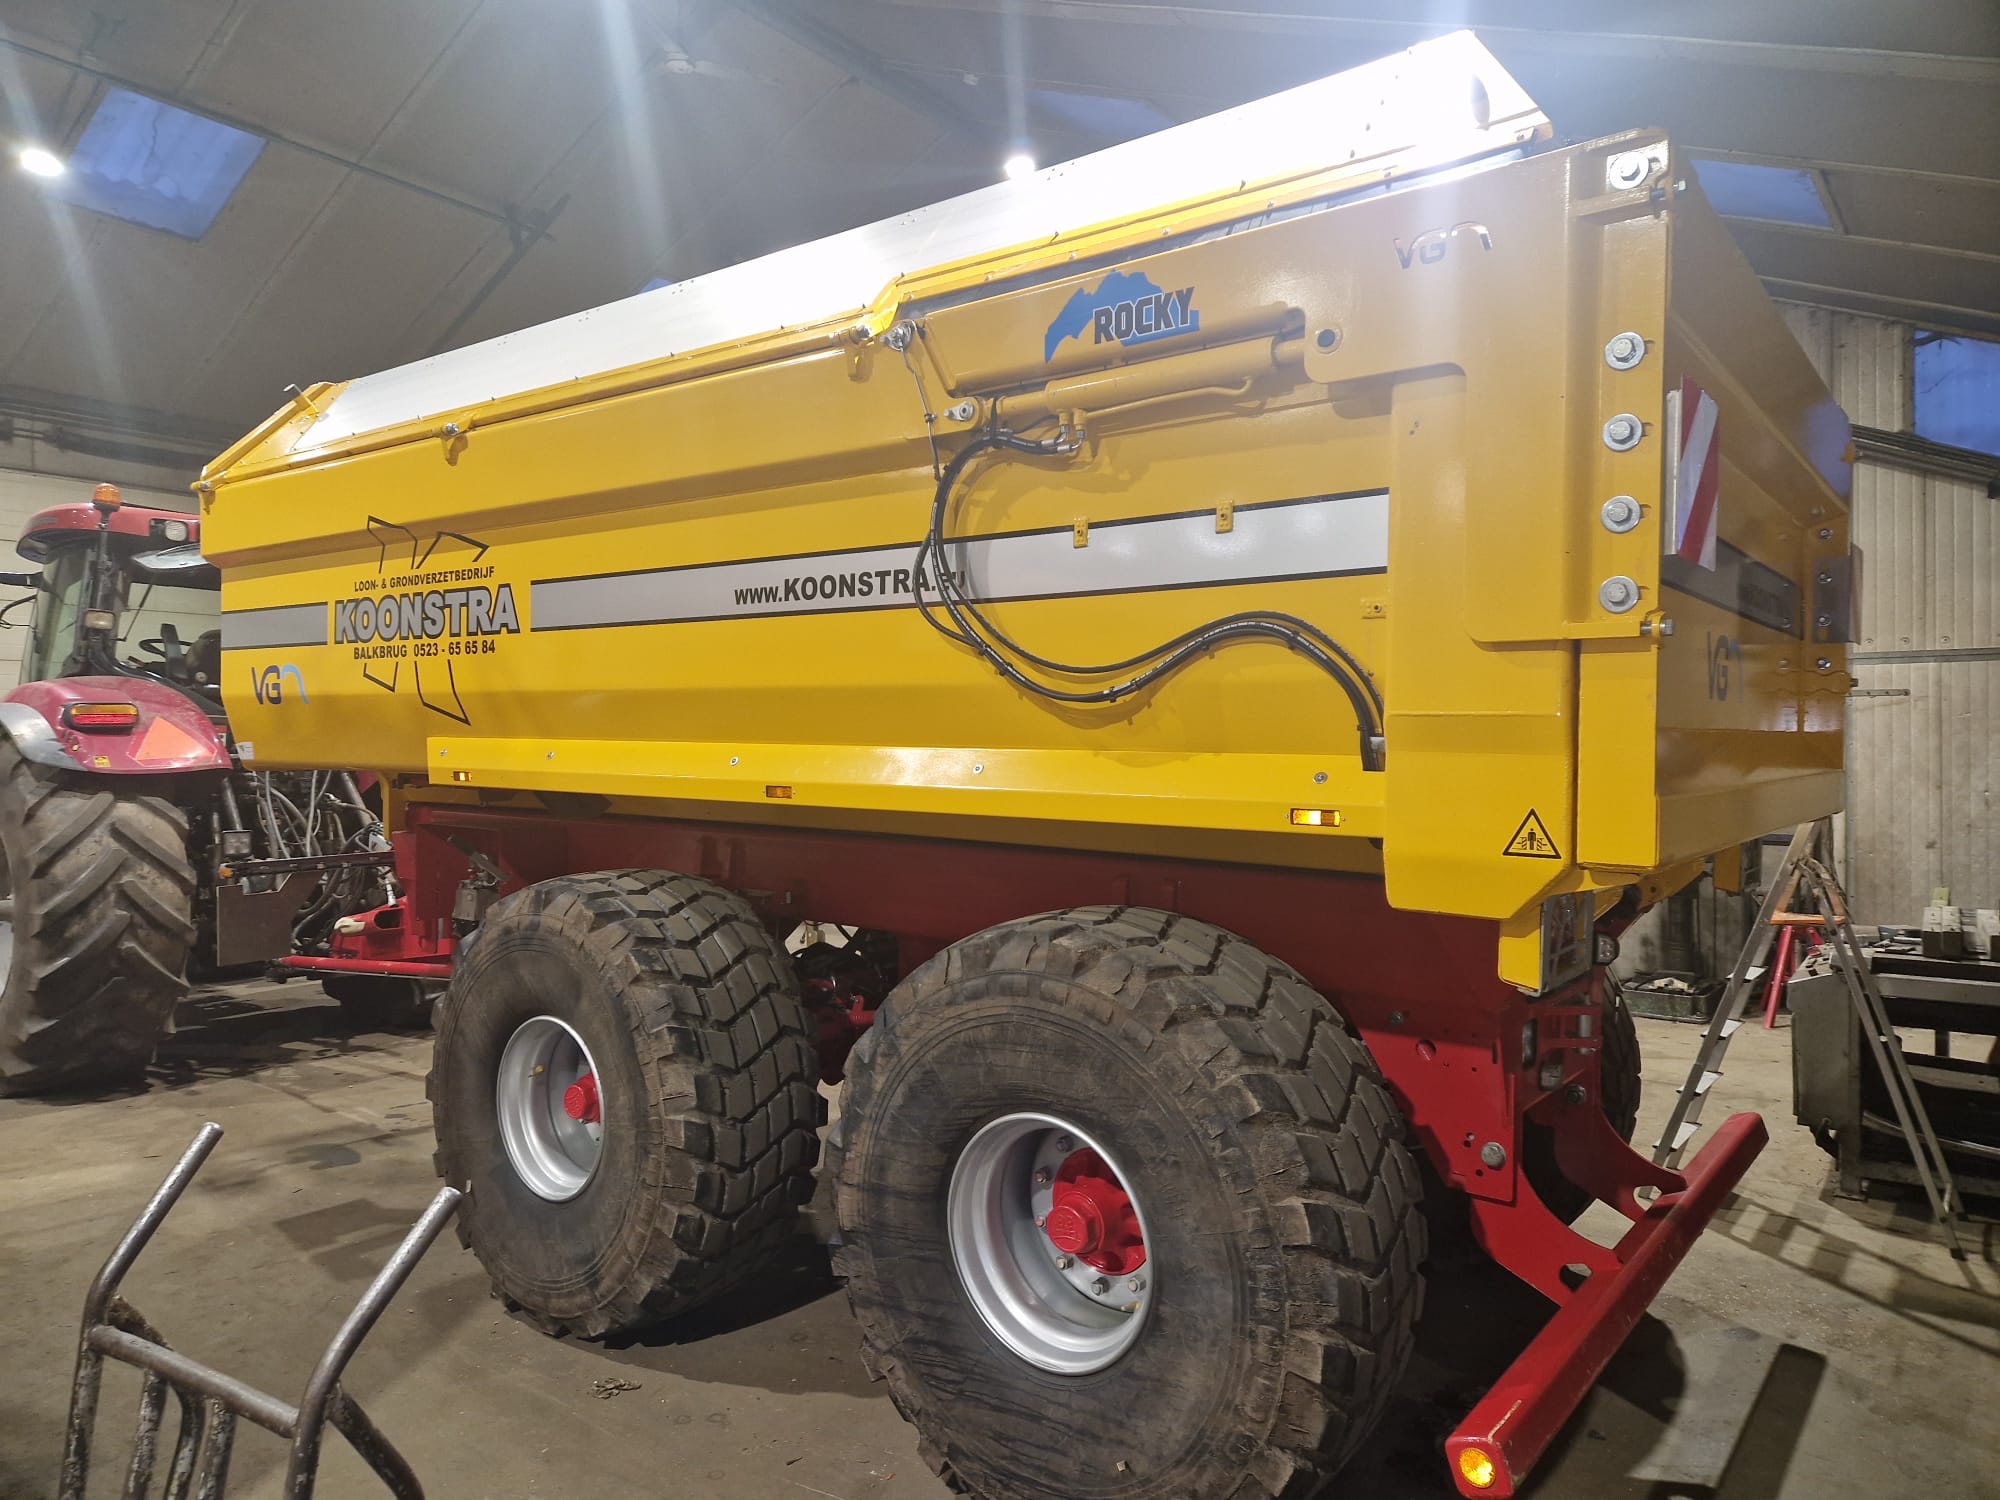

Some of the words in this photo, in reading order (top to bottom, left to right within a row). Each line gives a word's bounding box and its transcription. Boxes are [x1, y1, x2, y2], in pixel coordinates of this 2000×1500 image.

[1094, 287, 1195, 345] ROCKY
[354, 580, 379, 592] LOON-
[381, 578, 387, 589] &
[389, 566, 495, 588] GRONDVERZETBEDRIJF
[335, 583, 520, 644] KOONSTRA
[353, 644, 407, 660] BALKBRUG
[413, 642, 438, 657] 0523
[448, 641, 461, 655] 65
[464, 640, 478, 655] 65
[481, 639, 496, 654] 84
